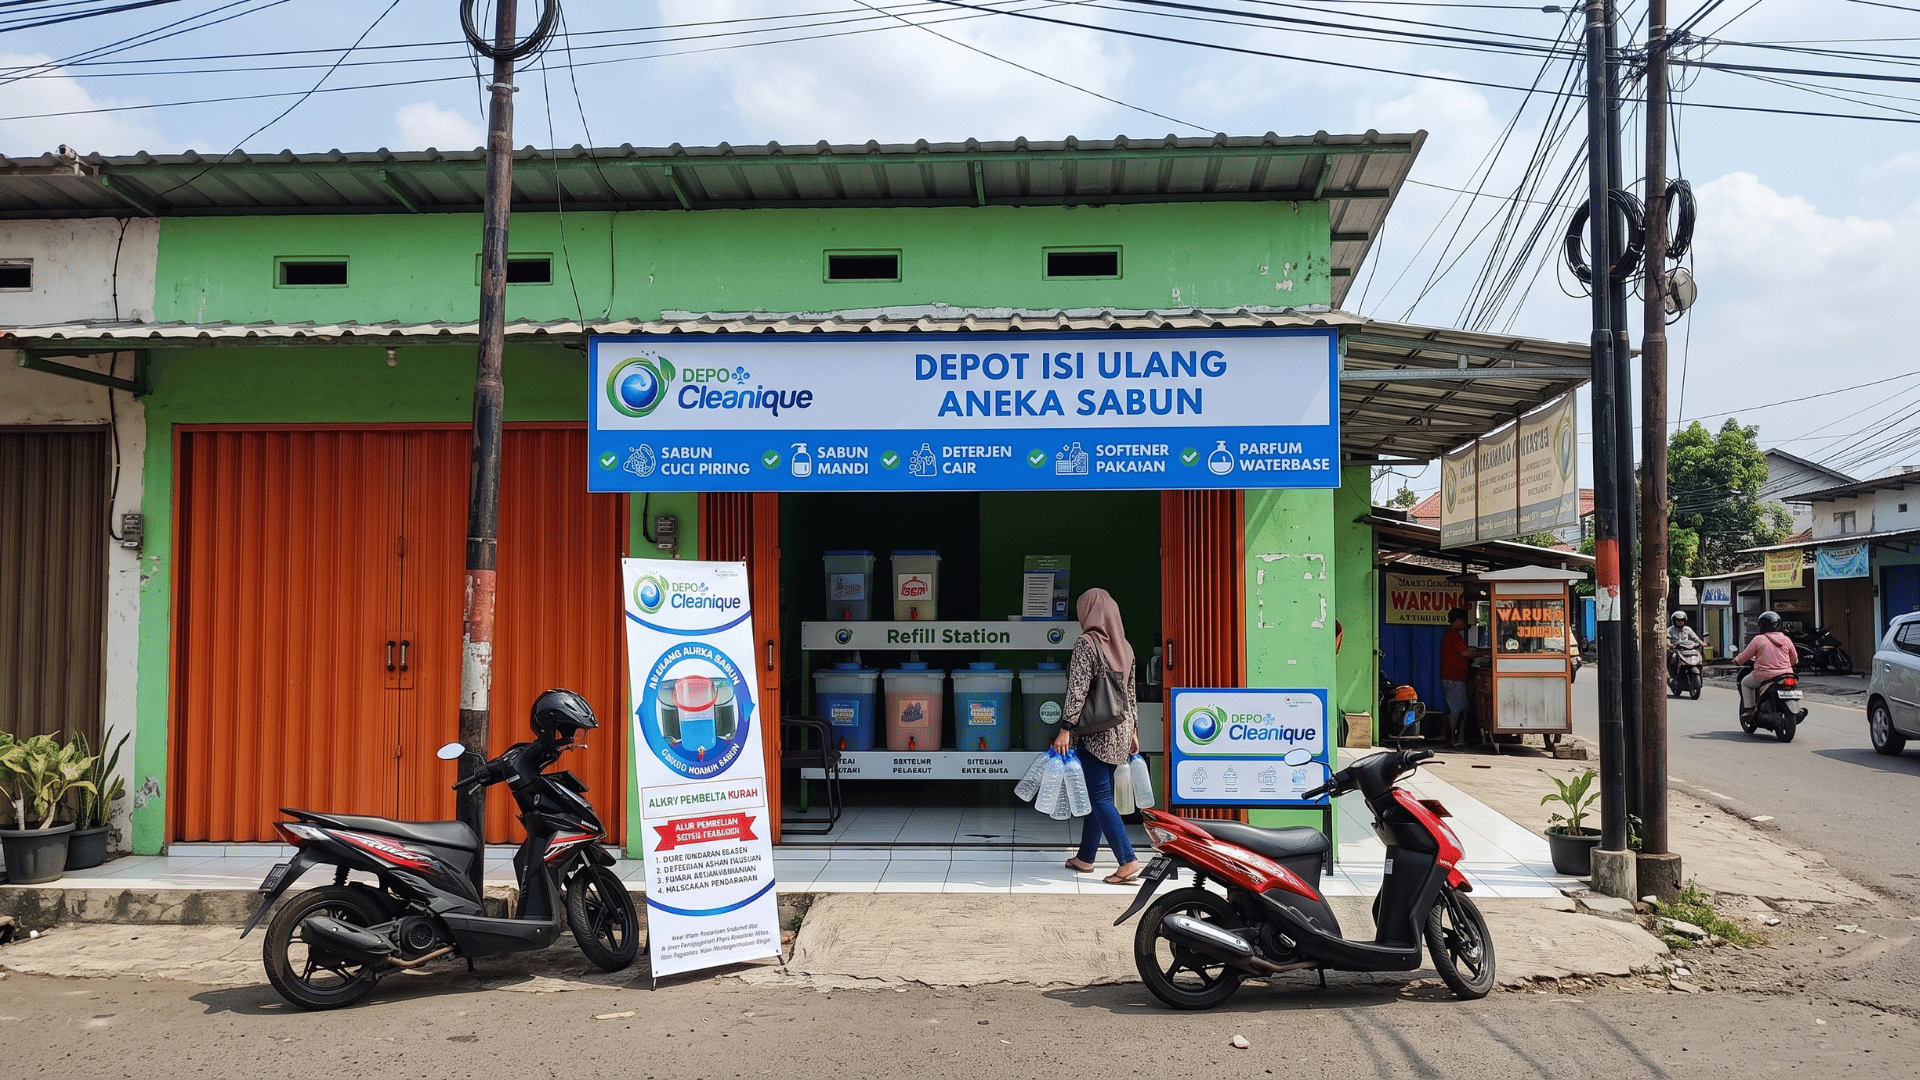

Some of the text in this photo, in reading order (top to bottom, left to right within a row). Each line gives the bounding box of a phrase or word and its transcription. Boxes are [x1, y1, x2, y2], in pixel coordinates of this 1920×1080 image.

[915, 350, 1228, 381] DEPOT ISI ULANG
[682, 368, 730, 383] DEPO
[678, 384, 813, 417] Cleanique
[937, 387, 1203, 417] ANEKA SABUN
[661, 447, 713, 459] SABUN
[817, 446, 869, 459] SABUN
[942, 445, 1012, 458] DETERJEN
[1096, 443, 1170, 457] SOFTENER
[1239, 442, 1303, 455] PARFUM
[661, 462, 750, 475] CUCI PIRING
[817, 462, 869, 475] MANDI
[942, 461, 977, 474] CAIR
[1096, 460, 1166, 473] PAKAIAN
[1239, 457, 1330, 472] WATERBASE
[672, 583, 698, 592] DEPO
[671, 593, 741, 612] Cleanique
[887, 628, 1010, 644] Refill Station
[1231, 714, 1262, 724] DEPO
[1229, 725, 1316, 745] Cleanique
[680, 791, 727, 805] PEMBELTA
[727, 788, 758, 800] KURAH
